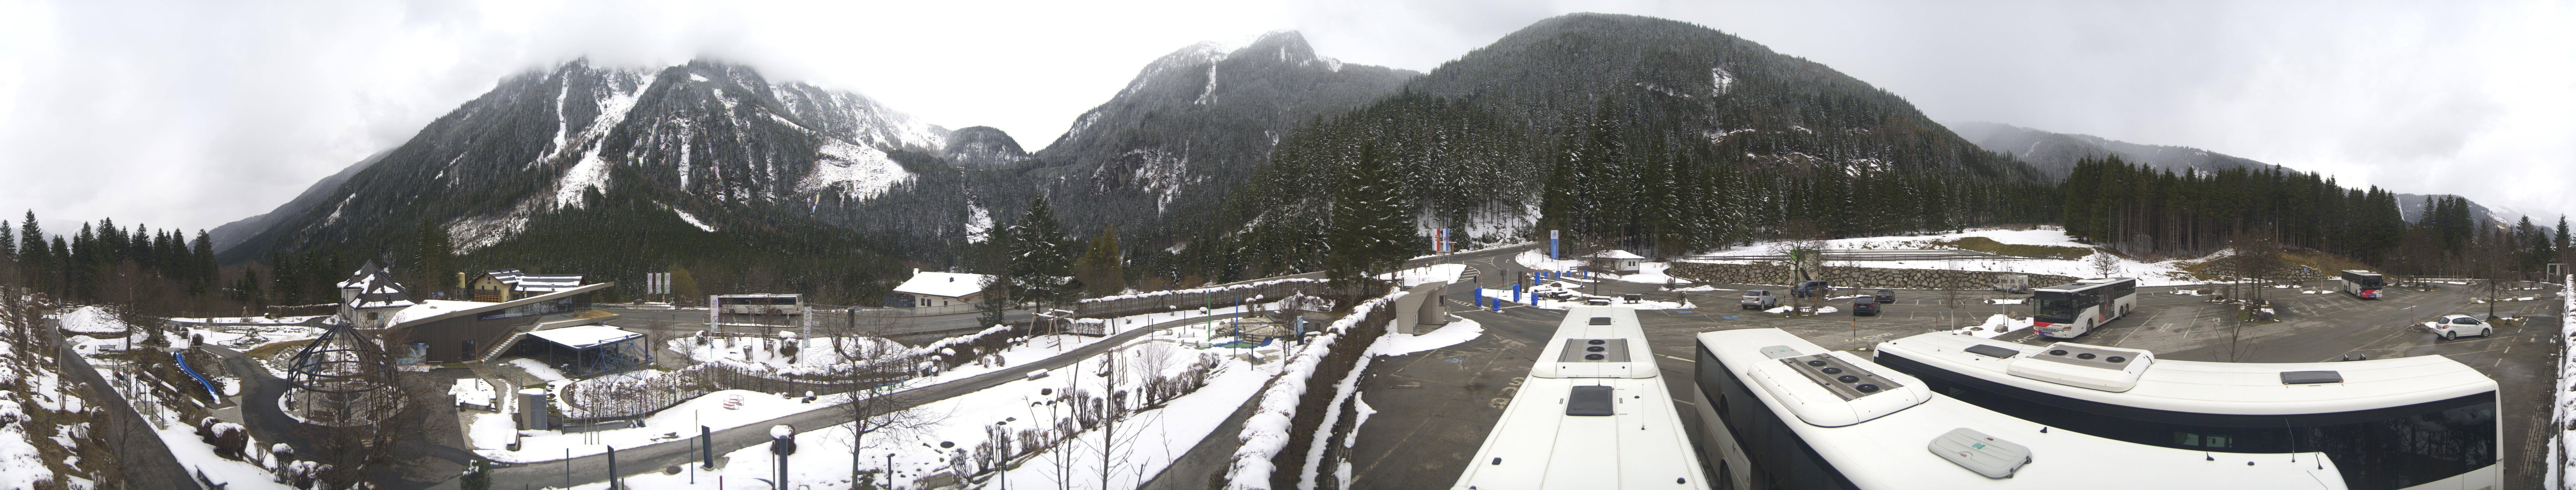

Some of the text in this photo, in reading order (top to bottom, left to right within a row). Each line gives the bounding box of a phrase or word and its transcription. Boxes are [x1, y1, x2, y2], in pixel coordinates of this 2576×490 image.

[2156, 323, 2173, 332] BUS
[1844, 333, 1894, 342] BUS
[2012, 334, 2038, 343] US
[1488, 377, 1526, 409] BUS
